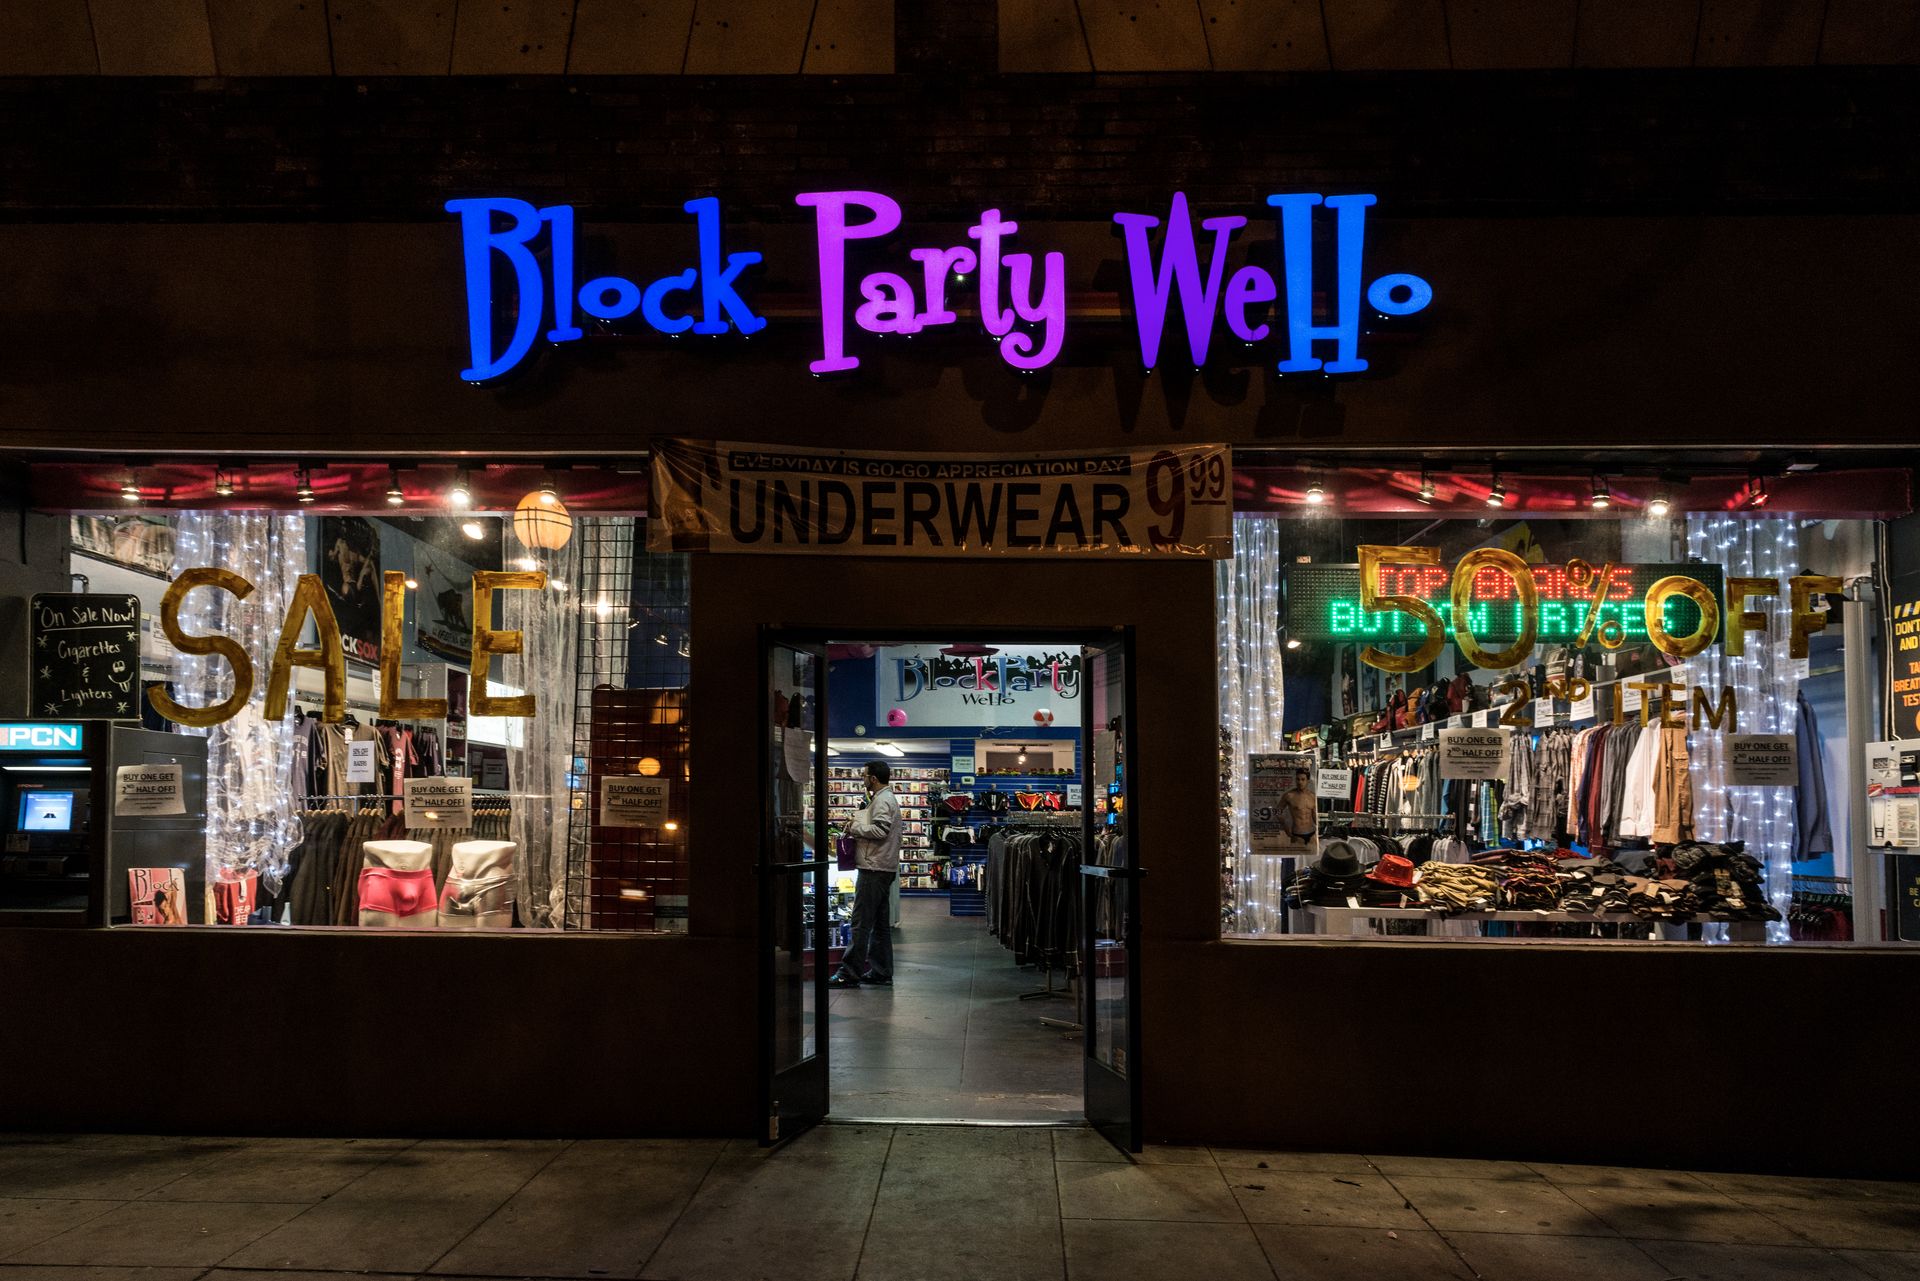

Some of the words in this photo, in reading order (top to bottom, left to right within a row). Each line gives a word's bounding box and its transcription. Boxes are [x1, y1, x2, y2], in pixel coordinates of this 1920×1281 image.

[445, 197, 767, 381] Block
[796, 191, 1065, 372] Party
[1114, 192, 1432, 373] WeHo
[732, 455, 836, 473] EVERYDAY
[842, 461, 861, 475] IS
[867, 462, 930, 478] GO-GO
[936, 462, 1080, 478] APPRECIATION
[1084, 459, 1127, 473] DAY
[730, 479, 1133, 547] UNDERWEAR
[1377, 567, 1449, 600] TOP
[41, 607, 66, 628] On
[72, 607, 99, 625] Sale
[101, 607, 135, 623] Now!
[1645, 574, 1843, 661] OFF
[57, 640, 121, 664] Cigarettes
[147, 568, 548, 727] SALE
[1899, 636, 1918, 651] AND
[61, 689, 113, 707] Lighters
[1613, 682, 1738, 735] ITEM
[9, 727, 77, 747] PCN
[1447, 736, 1464, 744] BUY
[1466, 736, 1484, 744] ONE
[1486, 737, 1502, 745] GET
[1462, 749, 1483, 757] HALF
[1485, 749, 1503, 758] OFF!
[124, 773, 138, 781] BUY
[140, 773, 156, 781] ONE
[159, 773, 174, 781] GET
[158, 785, 176, 793] OFF!
[644, 799, 661, 807] OFF!
[134, 869, 179, 901] Block
